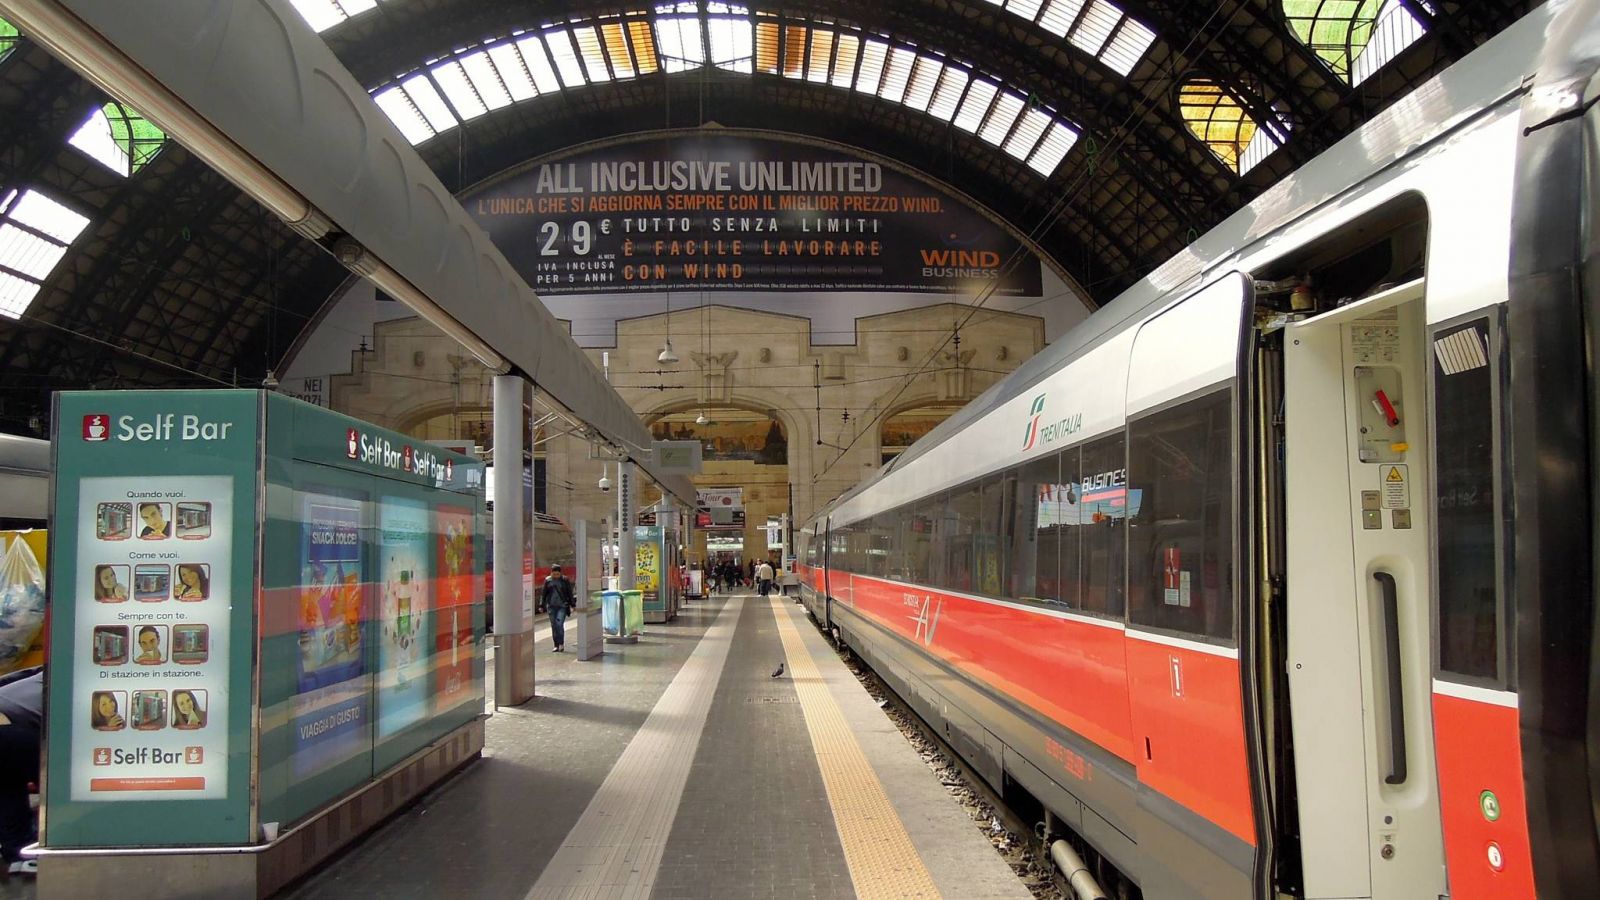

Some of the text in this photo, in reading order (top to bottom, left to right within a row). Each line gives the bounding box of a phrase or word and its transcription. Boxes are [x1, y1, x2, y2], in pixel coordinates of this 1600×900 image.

[536, 161, 882, 194] ALL INCLUSIVE UNLIMITED
[478, 194, 945, 215] L'UNICA CHE SI AGGIORNA SEMPRE CON IL MIGLIOR PREZZO WIND.
[624, 217, 878, 233] TUTTO SENZA LIMITI
[540, 219, 611, 256] 29 €
[624, 238, 880, 256] È FACILE LAVORARE
[537, 261, 615, 272] IVA INCLUSA
[920, 249, 1000, 268] WIND
[537, 273, 613, 284] PER 5 ANNI
[624, 263, 743, 280] CON WIND
[922, 267, 998, 279] BUSINESS
[304, 379, 322, 392] NEI
[117, 413, 233, 442] Self Bar
[1040, 413, 1082, 445] TRENITALIA
[361, 433, 402, 469] Self Bar
[413, 449, 445, 479] Self Bar
[126, 490, 186, 498] Quando vuoi.
[312, 531, 336, 545] SNACK
[128, 551, 180, 559] Come vuoi.
[118, 612, 154, 621] Sempre
[175, 612, 188, 620] te.
[99, 669, 204, 678] Di stazione in stazione.
[301, 717, 329, 740] VIAGGIA
[336, 706, 360, 725] GUSTO
[114, 747, 182, 765] Self Bar
